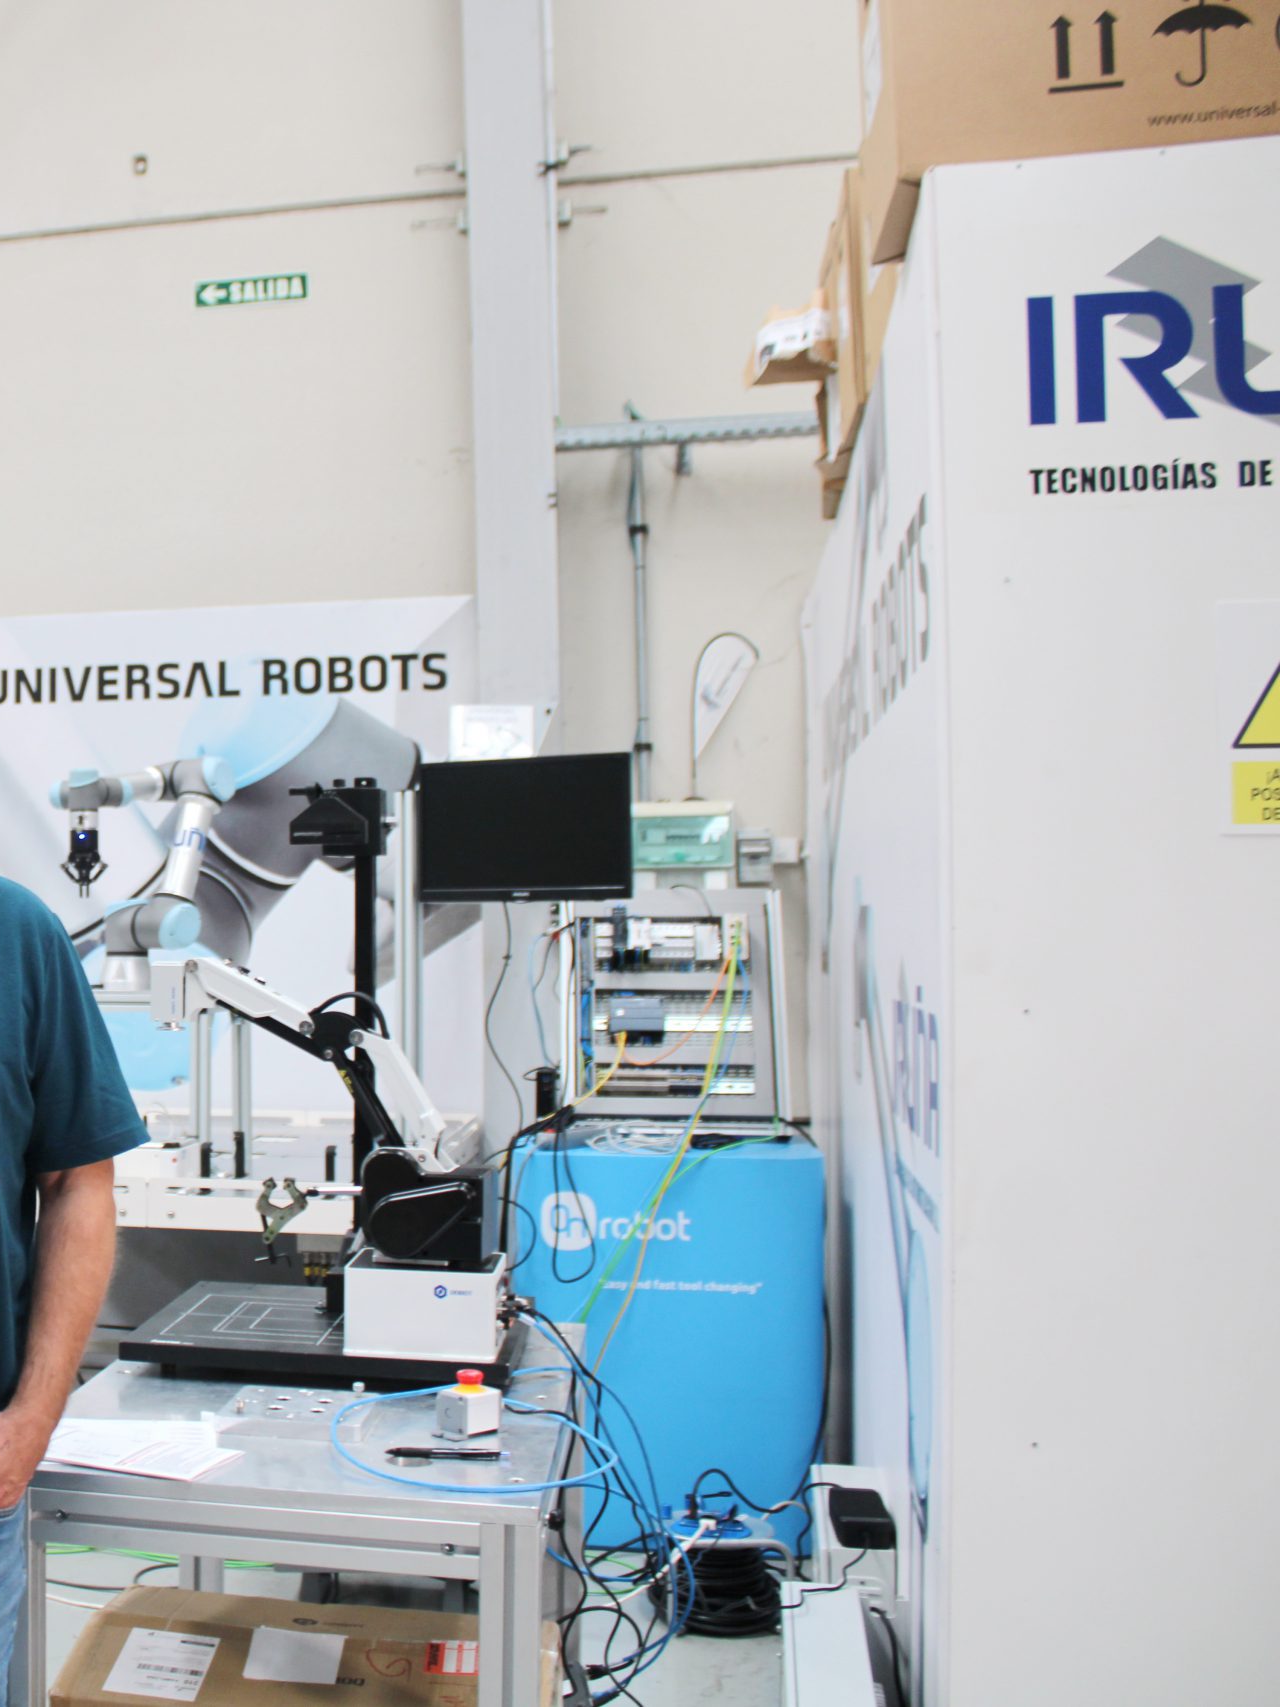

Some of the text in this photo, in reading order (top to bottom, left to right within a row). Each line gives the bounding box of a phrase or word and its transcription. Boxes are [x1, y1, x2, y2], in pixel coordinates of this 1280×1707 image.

[229, 276, 304, 304] SALIDA
[1030, 459, 1273, 494] TECNOLOGÍAS DE
[262, 652, 448, 697] ROBOTS
